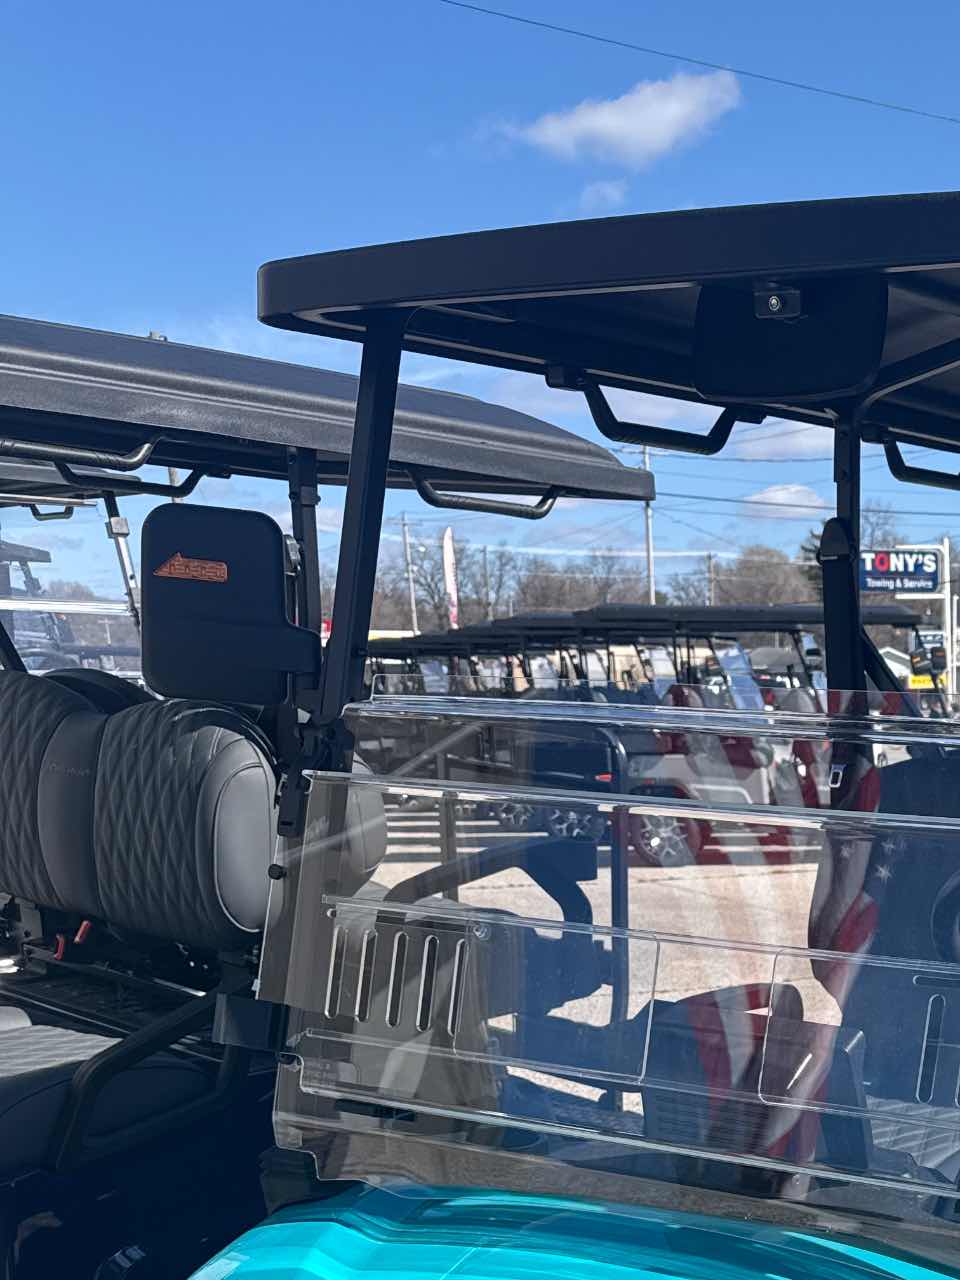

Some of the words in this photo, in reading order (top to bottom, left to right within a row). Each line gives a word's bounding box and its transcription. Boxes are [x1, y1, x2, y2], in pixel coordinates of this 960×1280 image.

[861, 553, 936, 573] TONY'S
[866, 578, 894, 589] Towing
[903, 579, 933, 589] Service
